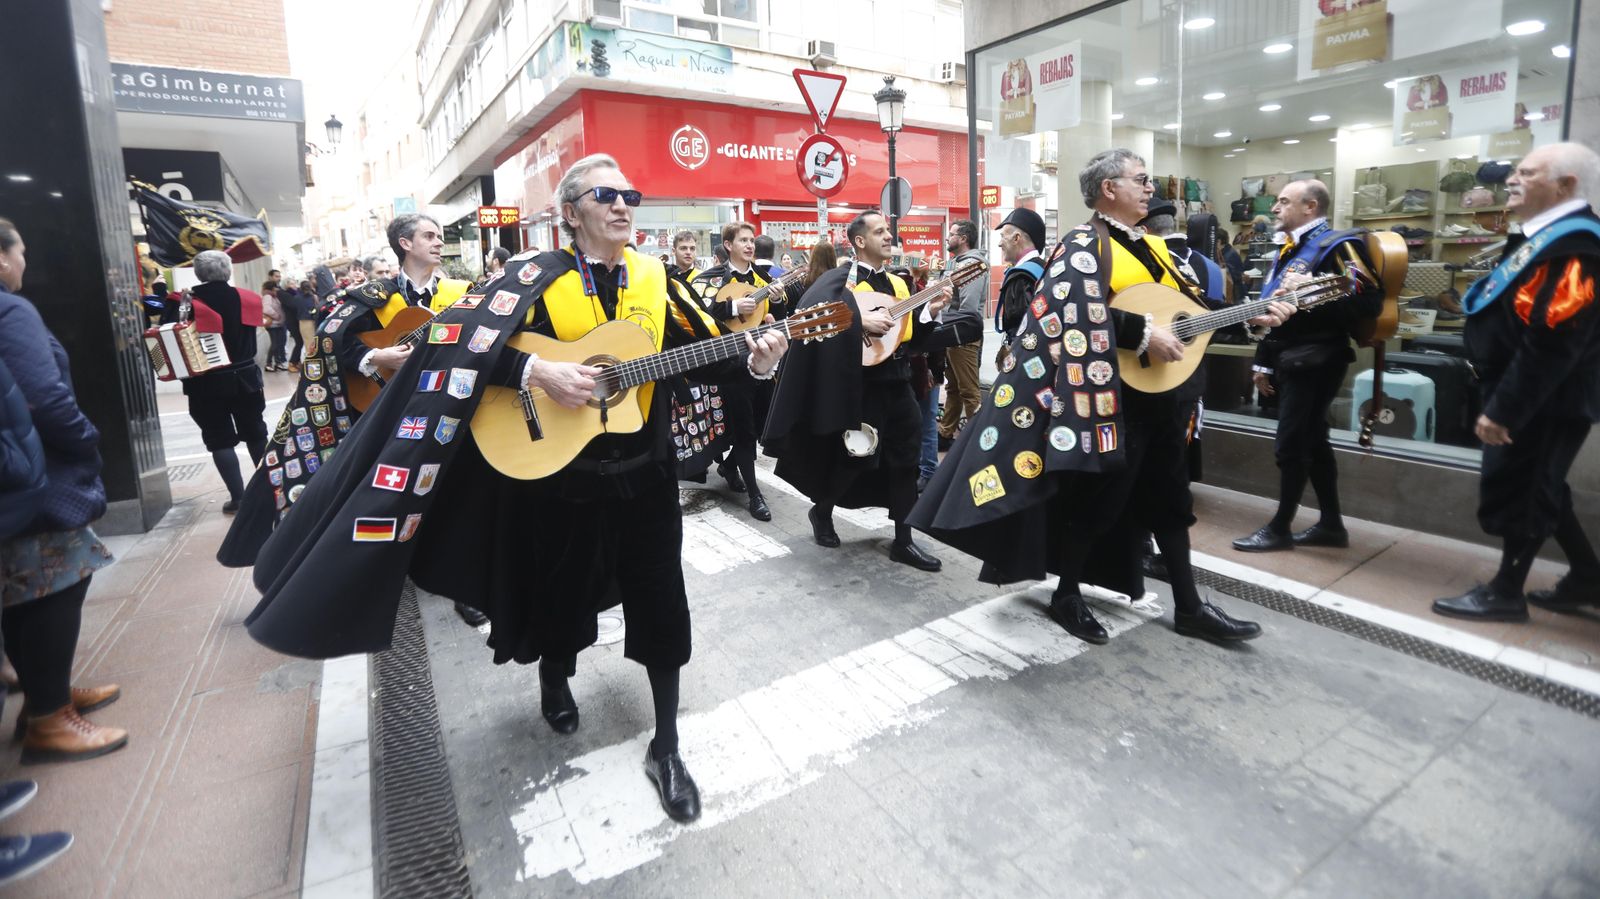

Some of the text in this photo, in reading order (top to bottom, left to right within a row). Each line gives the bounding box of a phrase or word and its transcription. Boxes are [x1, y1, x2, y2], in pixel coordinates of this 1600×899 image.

[1327, 28, 1370, 46] PAYMA
[616, 40, 726, 75] Raquel Nines
[1039, 54, 1074, 86] REBAJAS
[1459, 71, 1507, 98] REBAJAS
[1005, 111, 1026, 120] PAYMA
[1410, 119, 1439, 128] PAYMA
[676, 137, 704, 157] GE
[724, 142, 784, 161] GIGANTE
